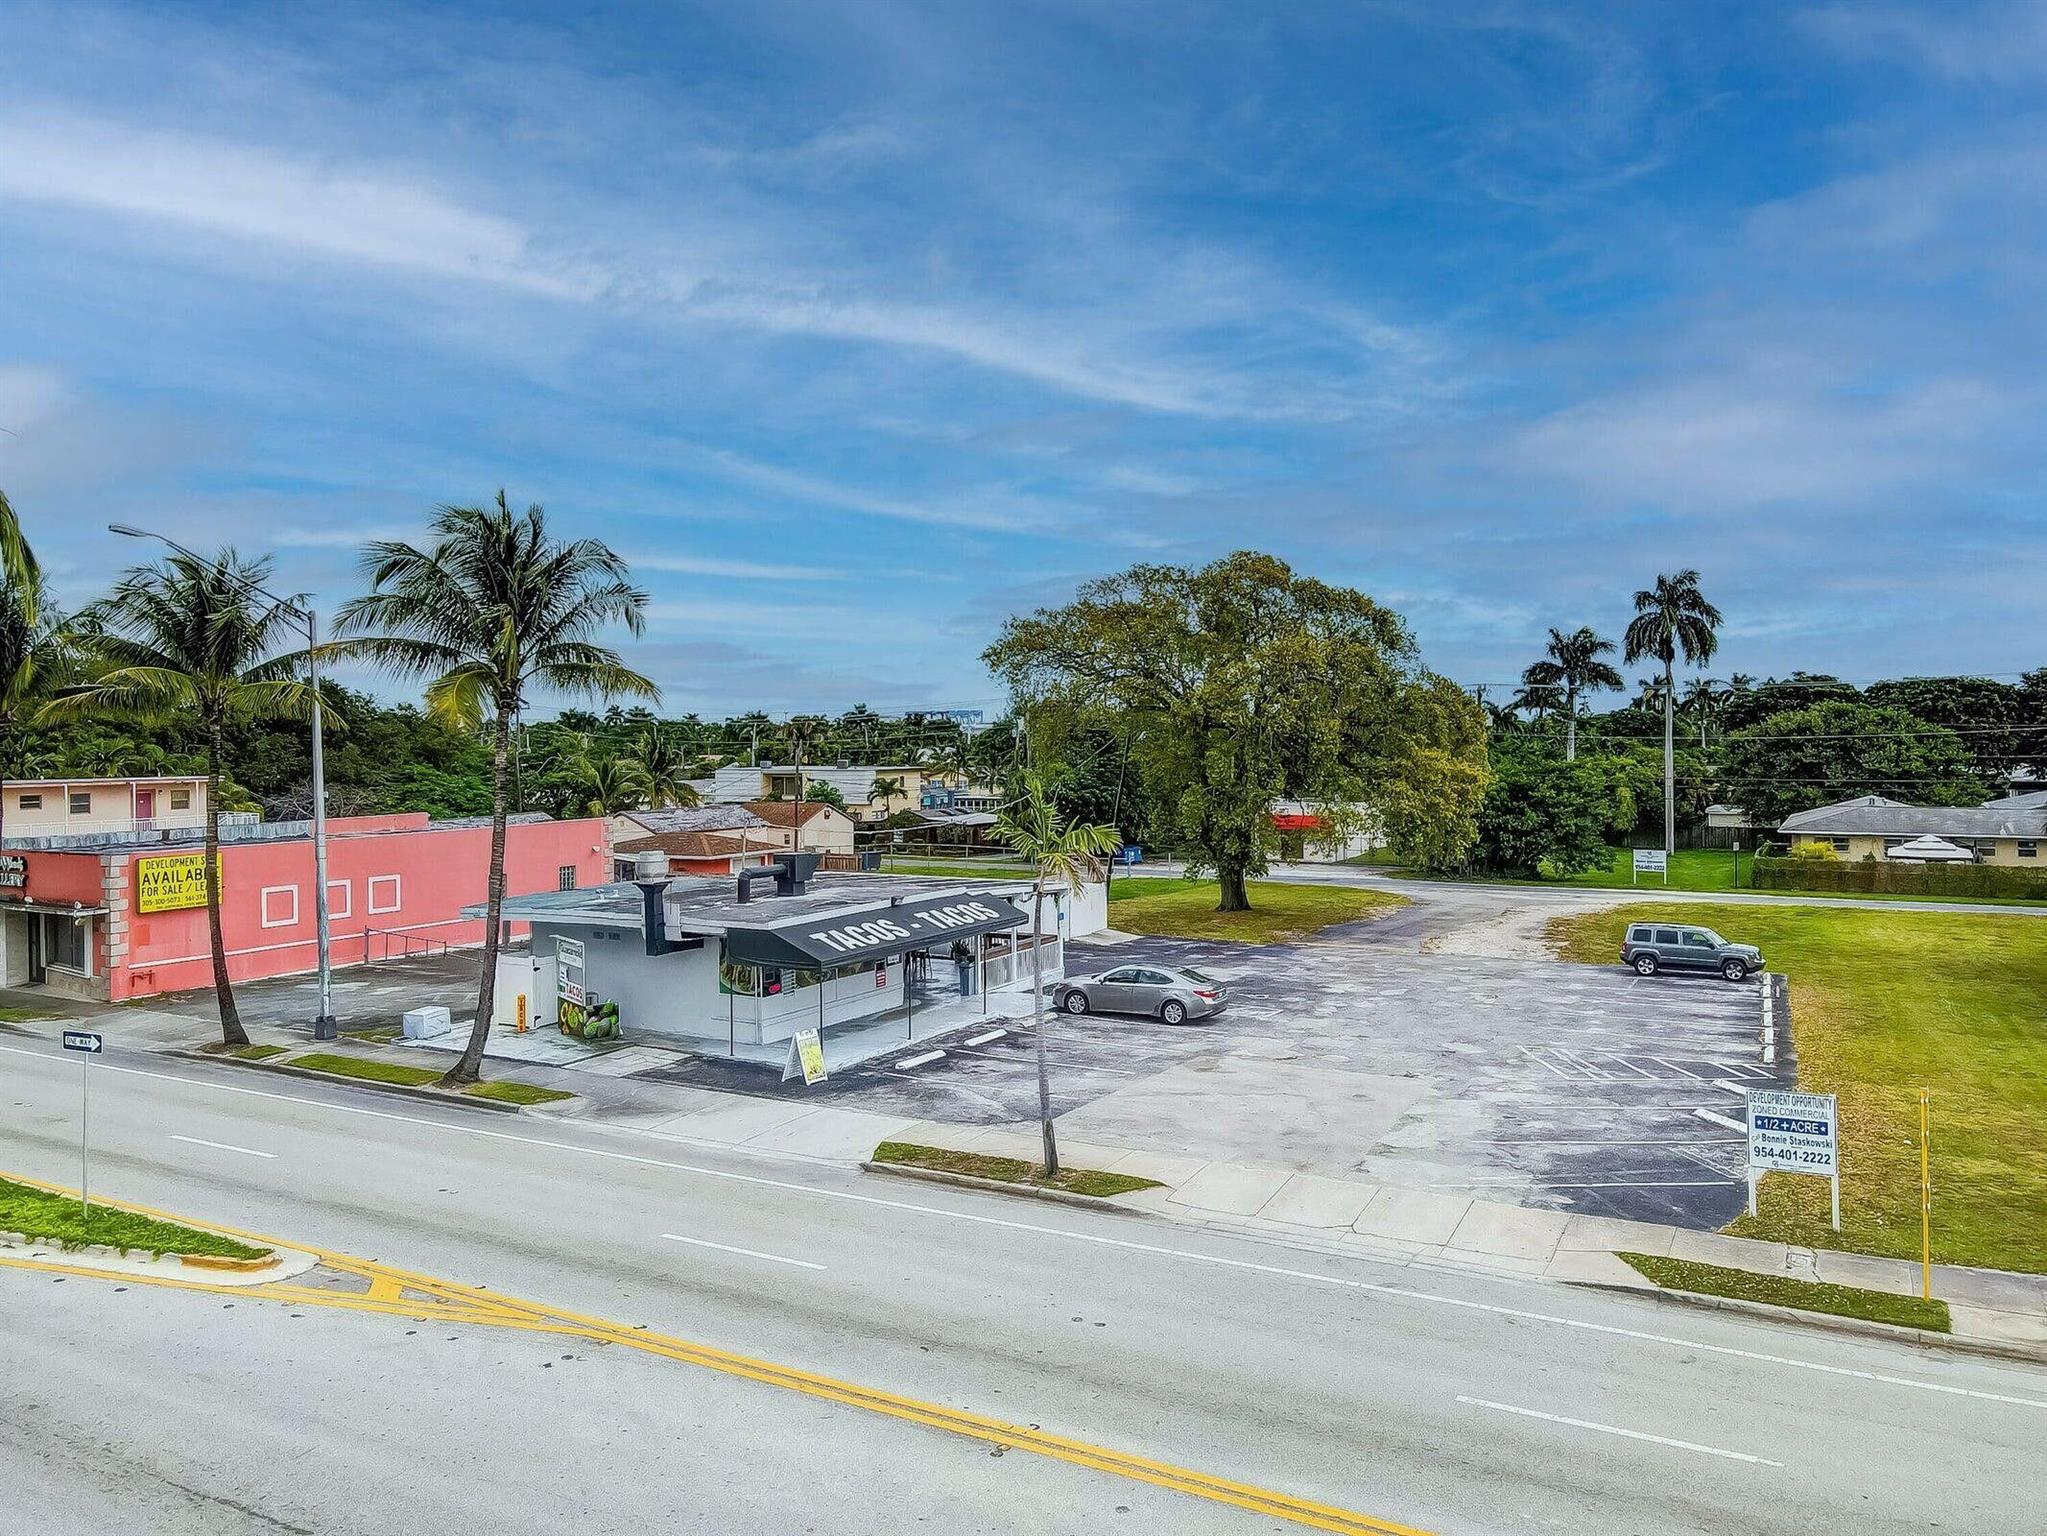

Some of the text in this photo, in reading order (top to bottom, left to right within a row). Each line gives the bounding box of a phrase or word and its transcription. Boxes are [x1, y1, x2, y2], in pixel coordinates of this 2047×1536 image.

[146, 857, 198, 870] DEVELOPMENT
[142, 867, 219, 886] AVAILAB
[141, 886, 159, 897] FOR
[162, 884, 183, 896] SALE
[808, 918, 911, 952] TACOS
[913, 901, 1001, 929] TACOS
[67, 1036, 91, 1046] ONE WAY
[1749, 1092, 1832, 1110] DEVELOPMENT OPPORTUNITY
[1752, 1105, 1830, 1120] ZONED COMMERCIAL
[1761, 1133, 1787, 1145] Bonnie
[1789, 1136, 1833, 1149] Staskowski
[1753, 1146, 1831, 1165] 954-401-2222
